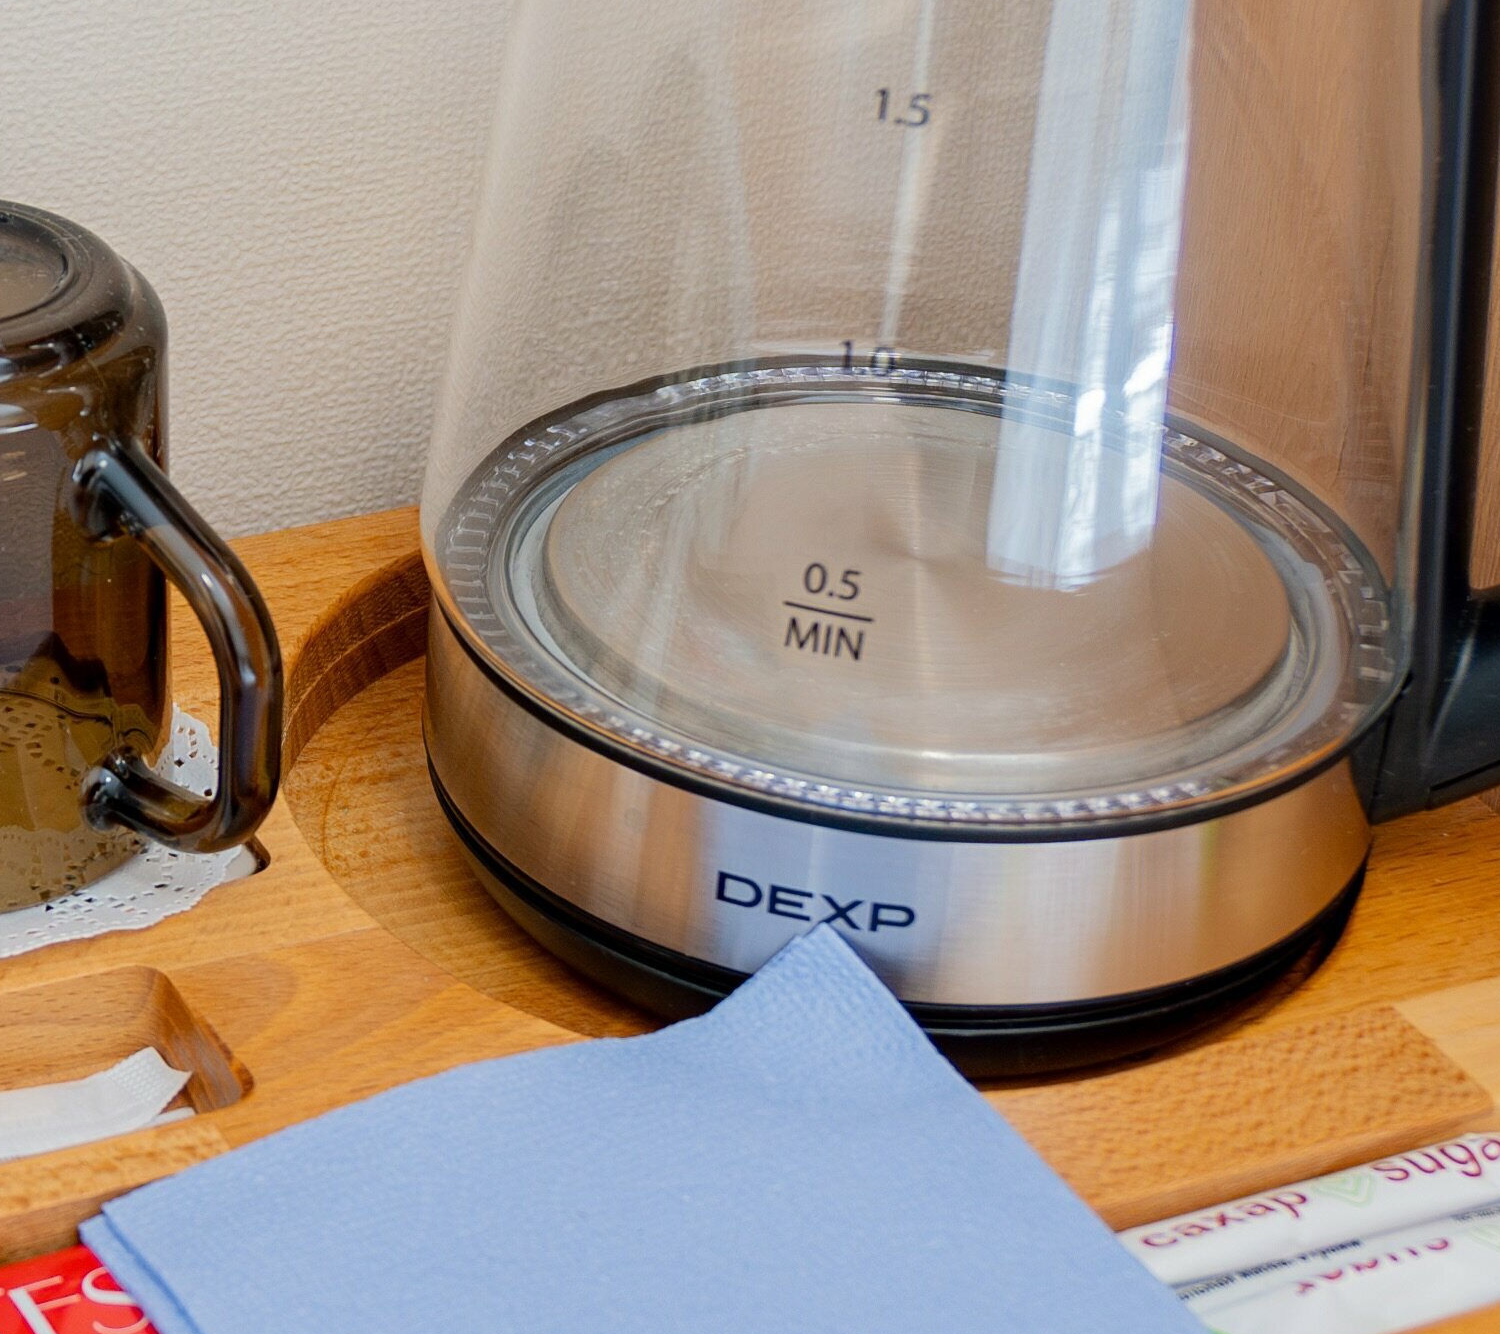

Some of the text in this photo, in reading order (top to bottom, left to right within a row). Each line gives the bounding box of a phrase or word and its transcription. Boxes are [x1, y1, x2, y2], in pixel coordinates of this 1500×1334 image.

[875, 87, 932, 127] 1.5
[839, 339, 897, 377] 1.0
[803, 562, 862, 600] 0.5
[784, 617, 865, 662] MIN
[714, 870, 917, 932] DEXP
